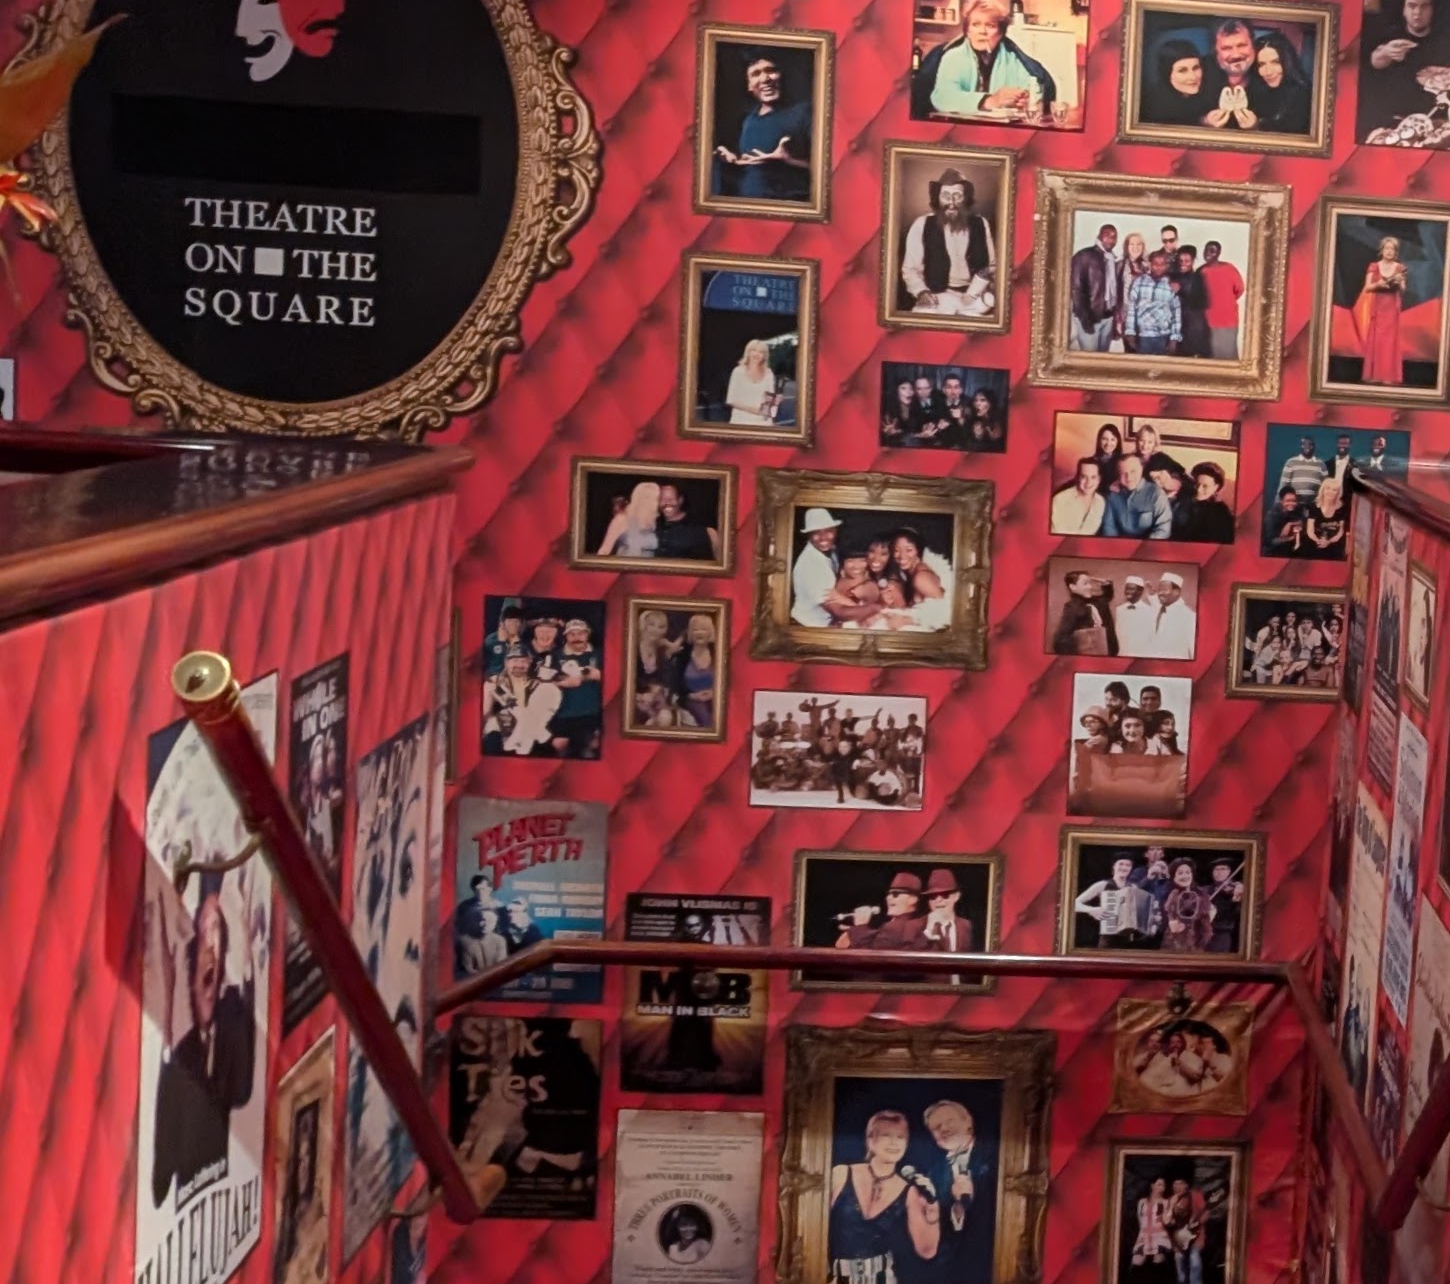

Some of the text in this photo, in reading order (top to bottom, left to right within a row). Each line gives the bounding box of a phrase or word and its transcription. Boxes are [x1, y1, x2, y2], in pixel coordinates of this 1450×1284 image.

[184, 197, 378, 237] THEATRE
[184, 242, 377, 282] ON THE
[184, 287, 375, 327] SQUARE
[472, 812, 577, 871] PLANET
[487, 839, 584, 891] PERTH
[636, 1004, 750, 1018] MAN IN BLACK
[459, 1017, 545, 1057] Silk
[457, 1063, 549, 1103] Ties
